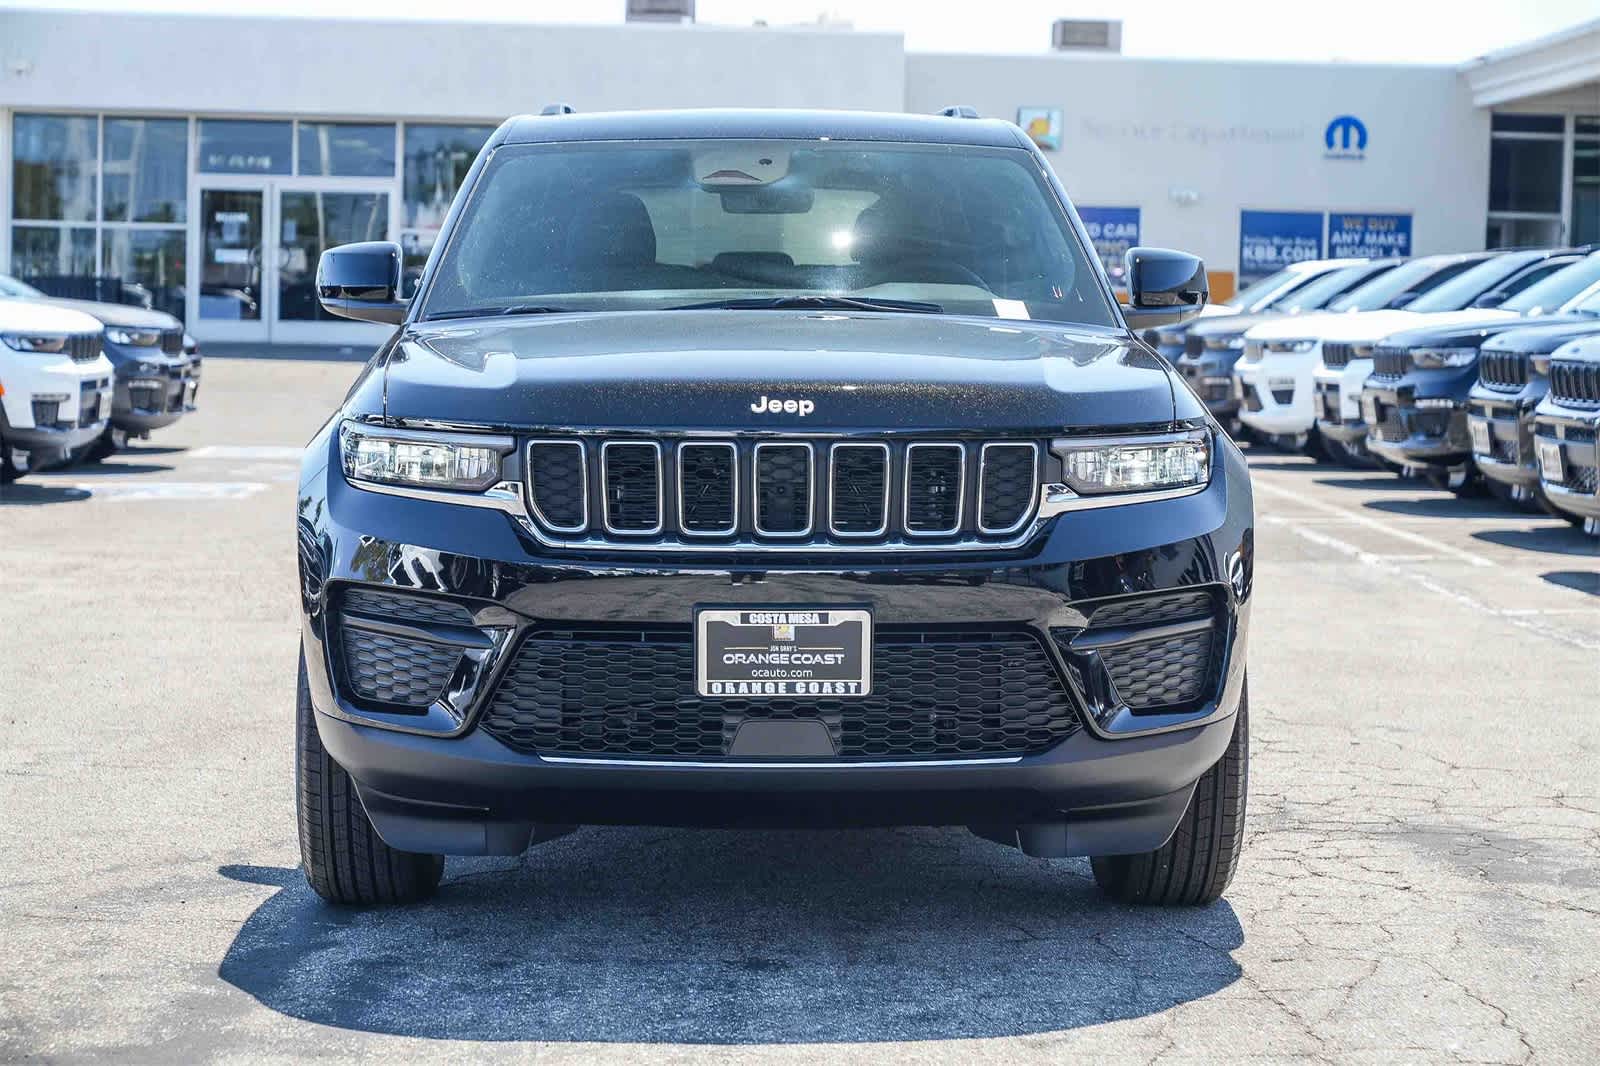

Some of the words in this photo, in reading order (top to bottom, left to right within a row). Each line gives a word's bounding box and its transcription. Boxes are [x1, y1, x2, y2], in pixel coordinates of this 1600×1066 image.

[1331, 231, 1362, 246] ANY
[1365, 232, 1407, 247] MAKE
[1242, 246, 1318, 260] KBB.COM
[1335, 246, 1384, 258] MODEL
[750, 395, 815, 417] Jeep
[749, 613, 787, 624] COSTA
[788, 613, 820, 624] MESA
[751, 668, 813, 678] ocauto.com
[711, 681, 787, 694] ORANGE
[795, 681, 858, 694] COAST
